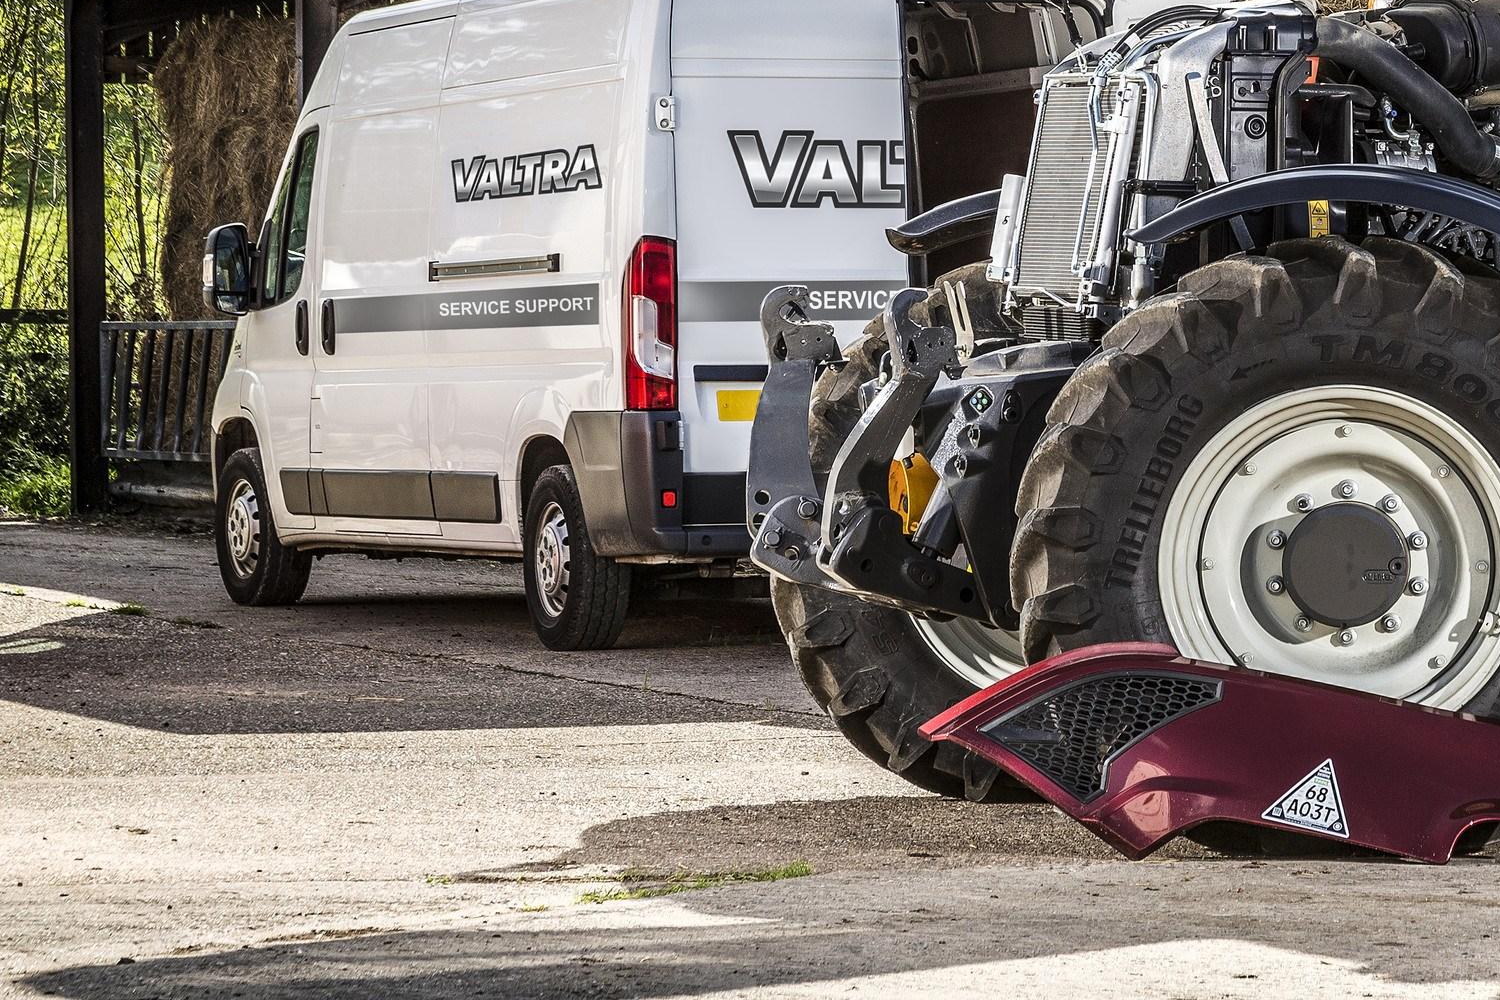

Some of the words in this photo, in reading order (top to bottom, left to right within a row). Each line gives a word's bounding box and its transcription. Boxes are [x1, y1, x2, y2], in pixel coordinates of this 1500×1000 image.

[451, 144, 602, 203] VALTRA
[439, 301, 510, 316] SERVICE
[515, 297, 594, 313] SUPPORT
[809, 290, 896, 310] SERVIC
[1103, 393, 1204, 590] TRELLEBORG
[1305, 785, 1329, 803] 68
